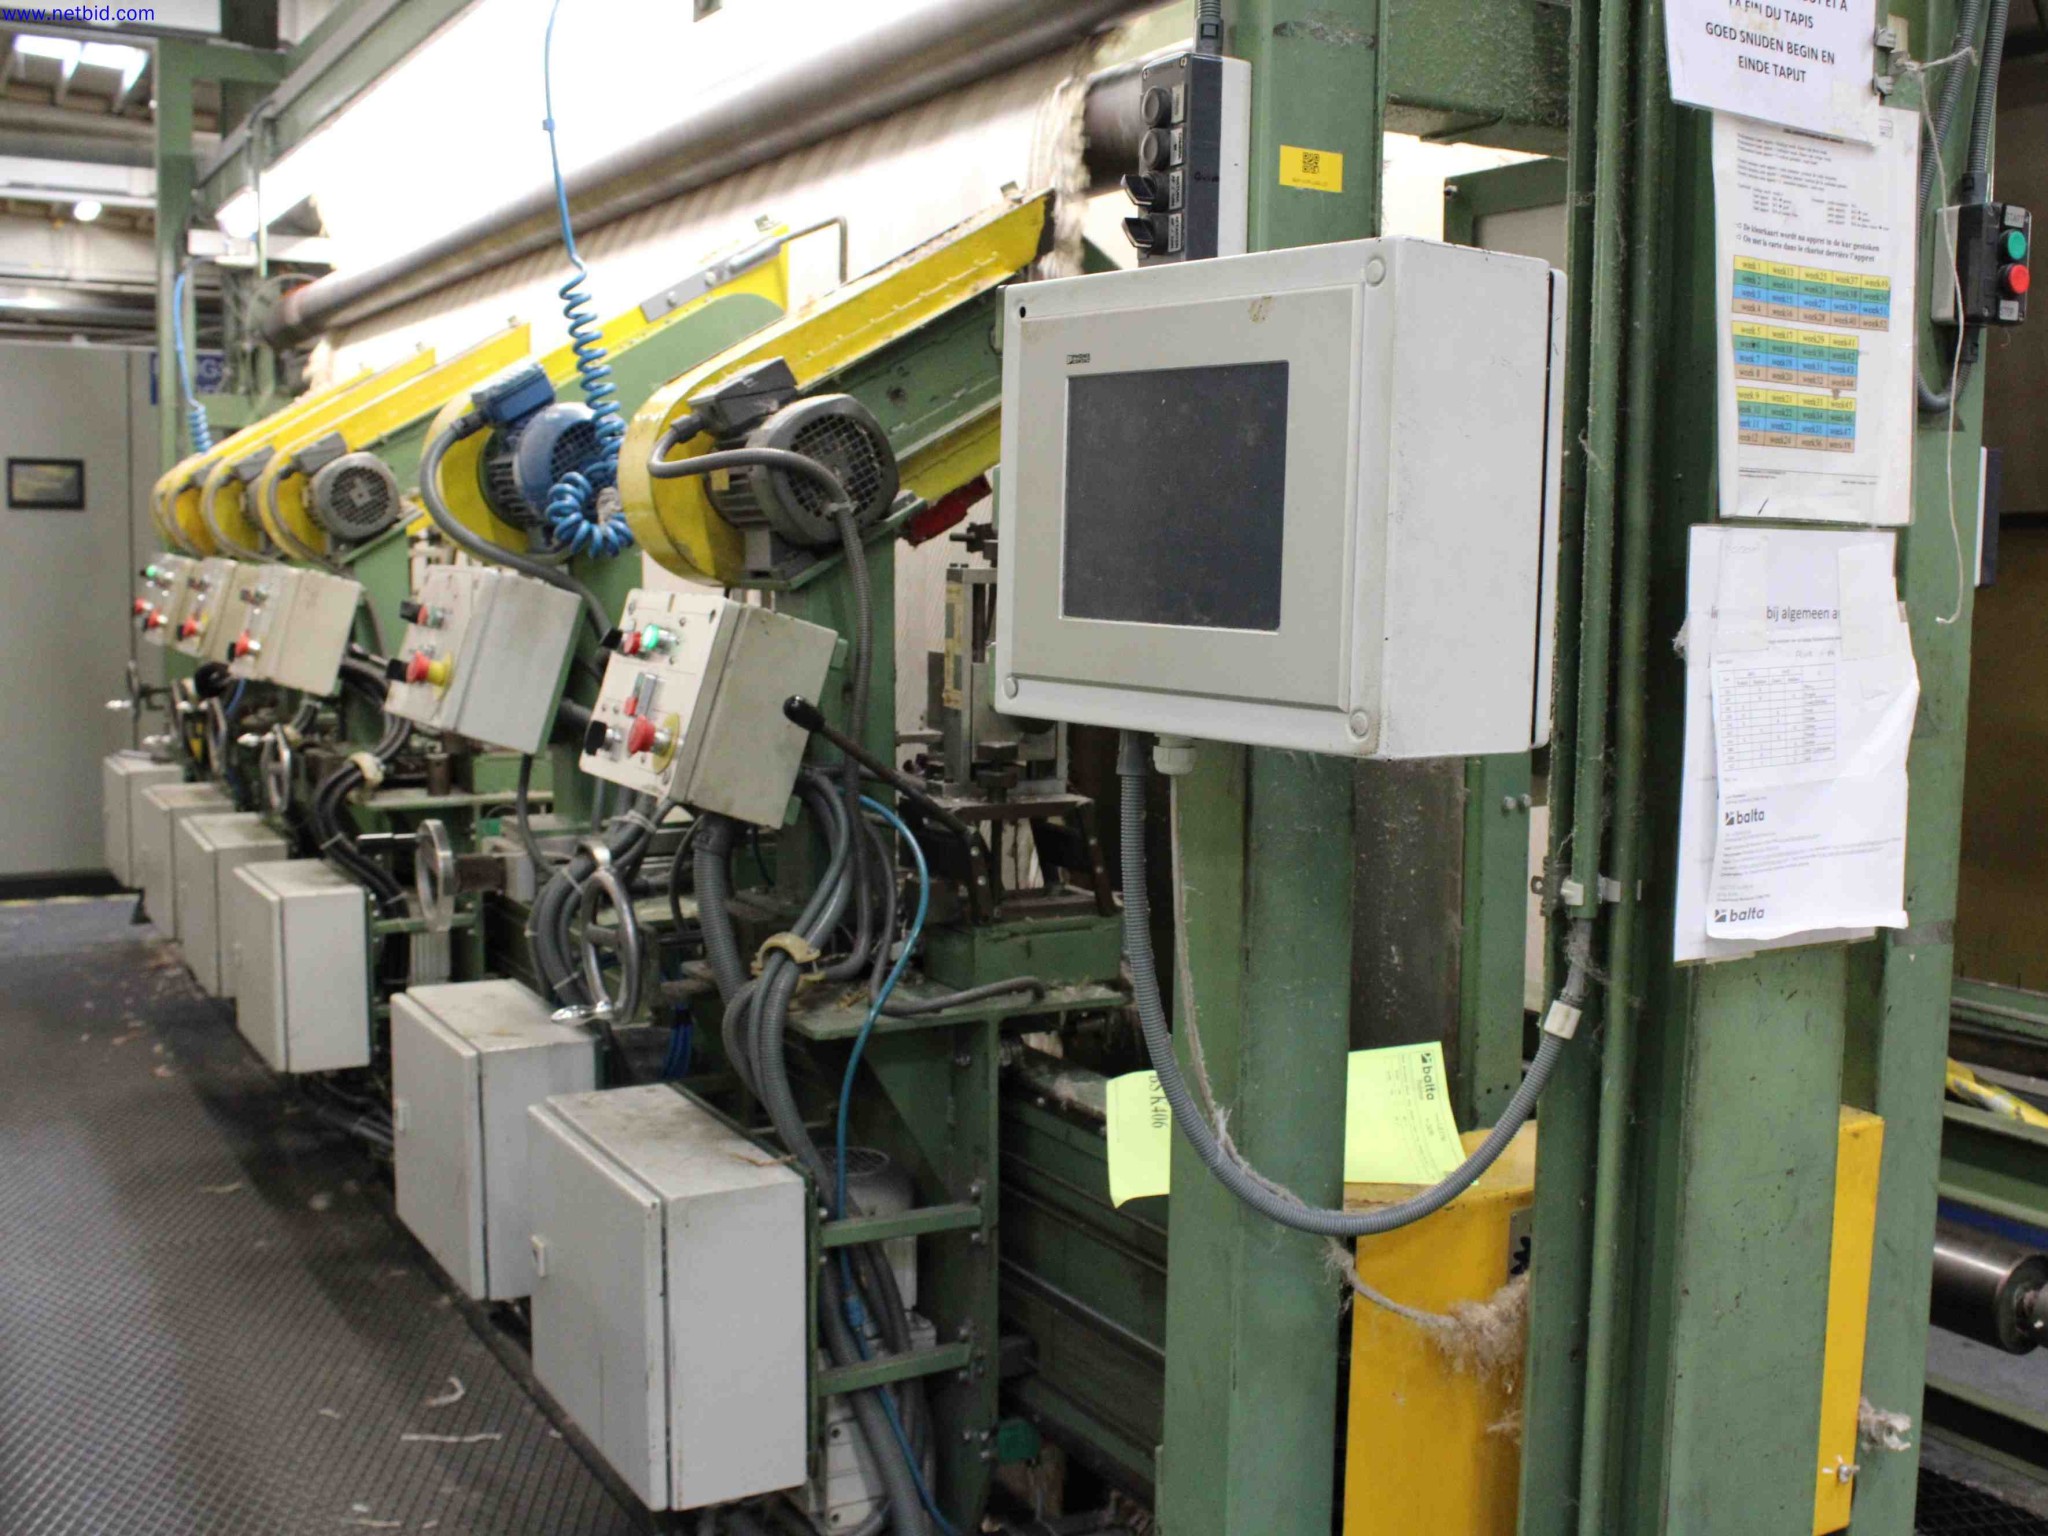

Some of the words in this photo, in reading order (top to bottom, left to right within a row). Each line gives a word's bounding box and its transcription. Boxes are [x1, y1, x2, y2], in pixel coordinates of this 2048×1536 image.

[1766, 5, 1781, 20] DU
[1784, 10, 1814, 29] TAPIS
[1705, 22, 1737, 41] GOED
[1740, 30, 1784, 53] SNIJDEN
[1787, 42, 1819, 61] BEGIN
[1821, 50, 1835, 65] EN
[1738, 55, 1770, 75] EINDE
[1773, 64, 1807, 83] TAPIJT
[1767, 606, 1778, 622] bij
[1782, 606, 1829, 622] algemeen
[1736, 809, 1765, 824] balta
[1729, 908, 1765, 922] balta
[1422, 1065, 1436, 1101] balta
